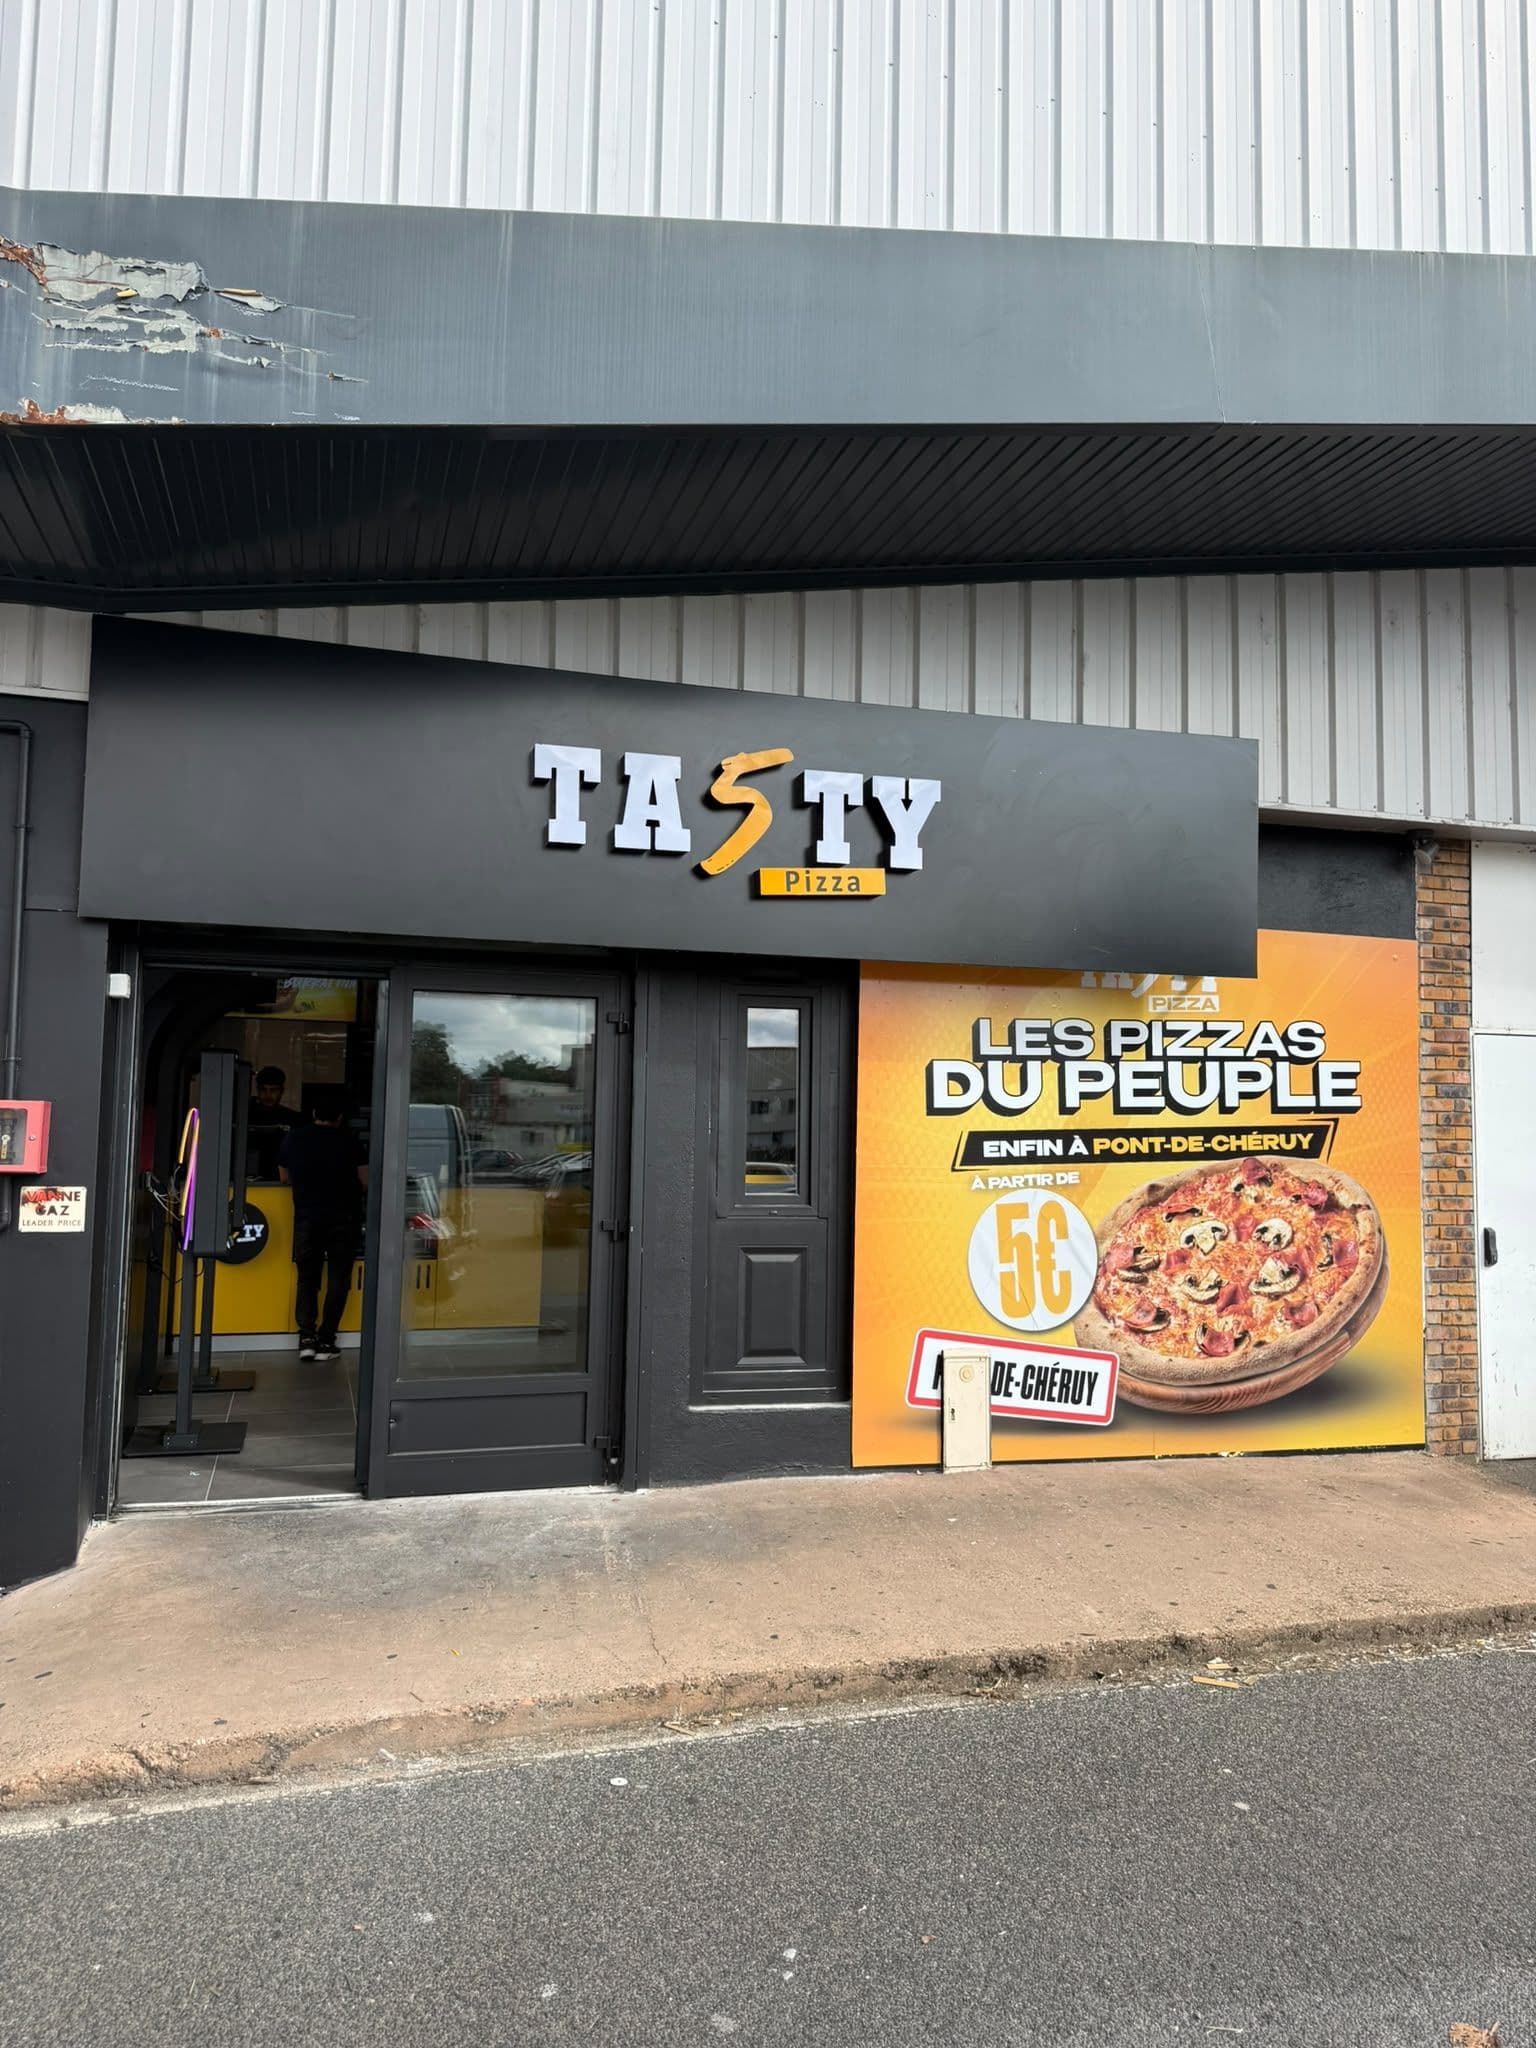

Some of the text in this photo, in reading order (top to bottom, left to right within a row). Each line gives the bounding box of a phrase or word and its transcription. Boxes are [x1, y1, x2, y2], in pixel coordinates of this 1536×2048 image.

[533, 743, 941, 875] TASTY
[785, 870, 861, 893] Pizza
[1151, 997, 1217, 1011] PIZZA
[975, 1017, 1326, 1060] LES PIZZAS
[929, 1059, 1362, 1112] DU PEUPLE
[983, 1131, 1314, 1158] ENFIN À PONT-DE-CHÉRUY
[970, 1171, 1080, 1191] À PARTIR DE
[22, 1219, 82, 1227] LEADER PRICE
[35, 1205, 70, 1216] GAZ
[995, 1200, 1072, 1319] 5€
